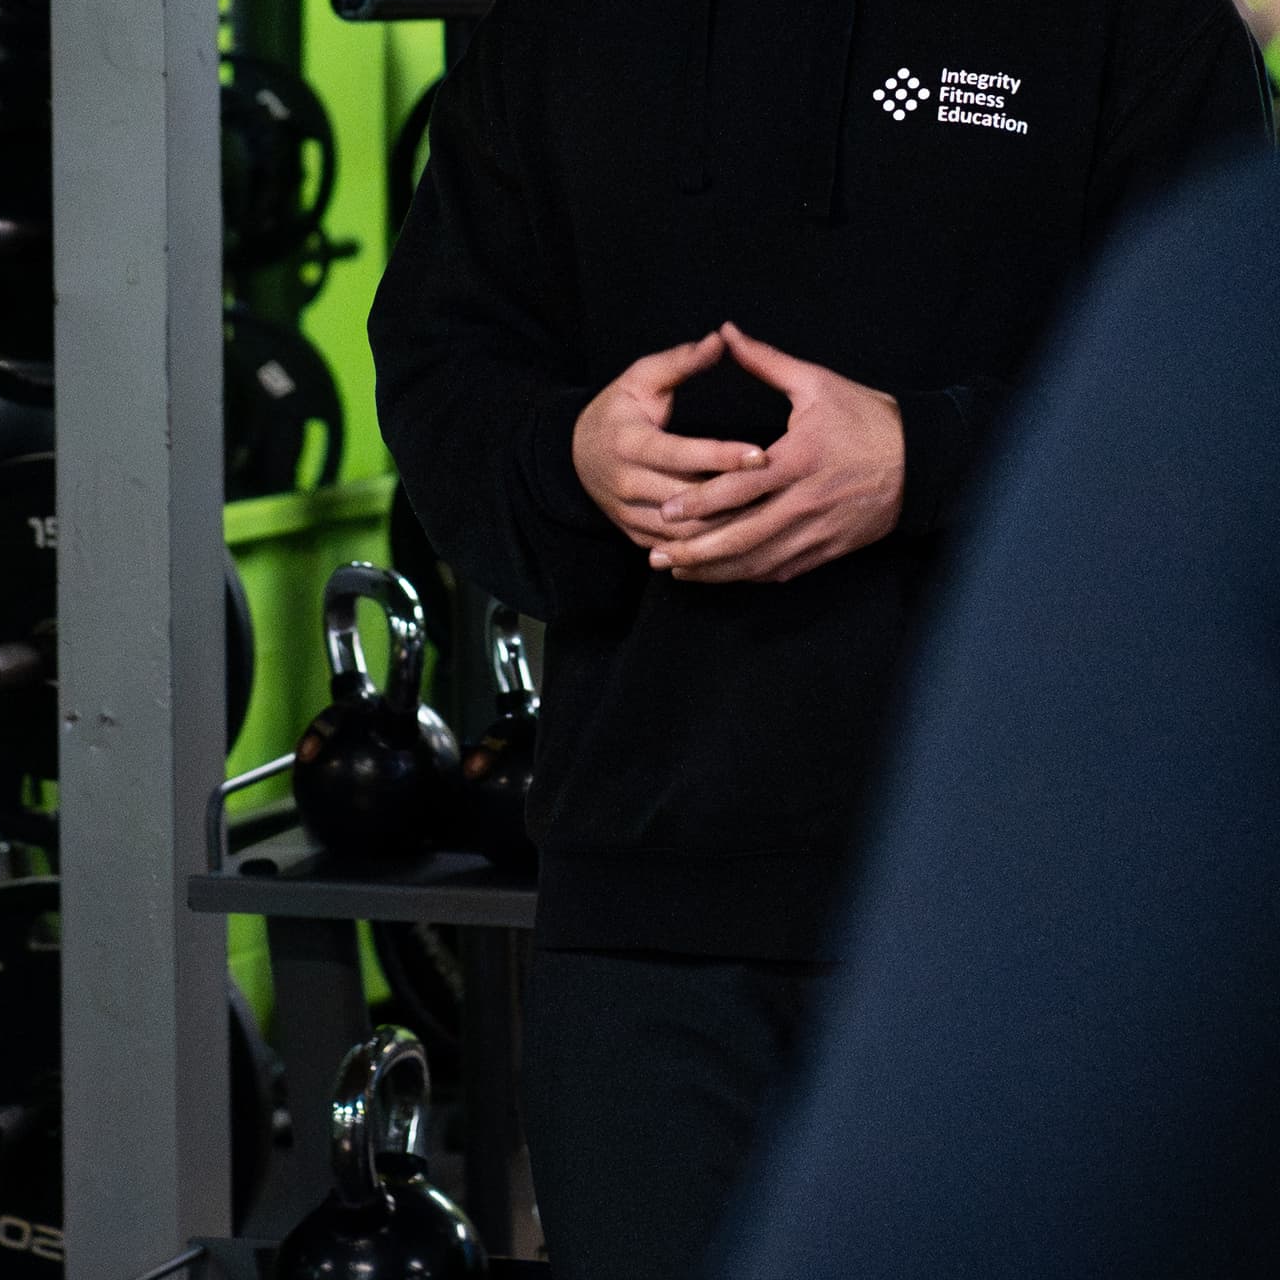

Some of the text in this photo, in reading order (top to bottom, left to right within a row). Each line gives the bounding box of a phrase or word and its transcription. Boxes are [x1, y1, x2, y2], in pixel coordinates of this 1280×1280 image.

[941, 67, 1022, 95] Integrity
[939, 86, 1005, 109] Fitness
[937, 105, 1029, 135] Education
